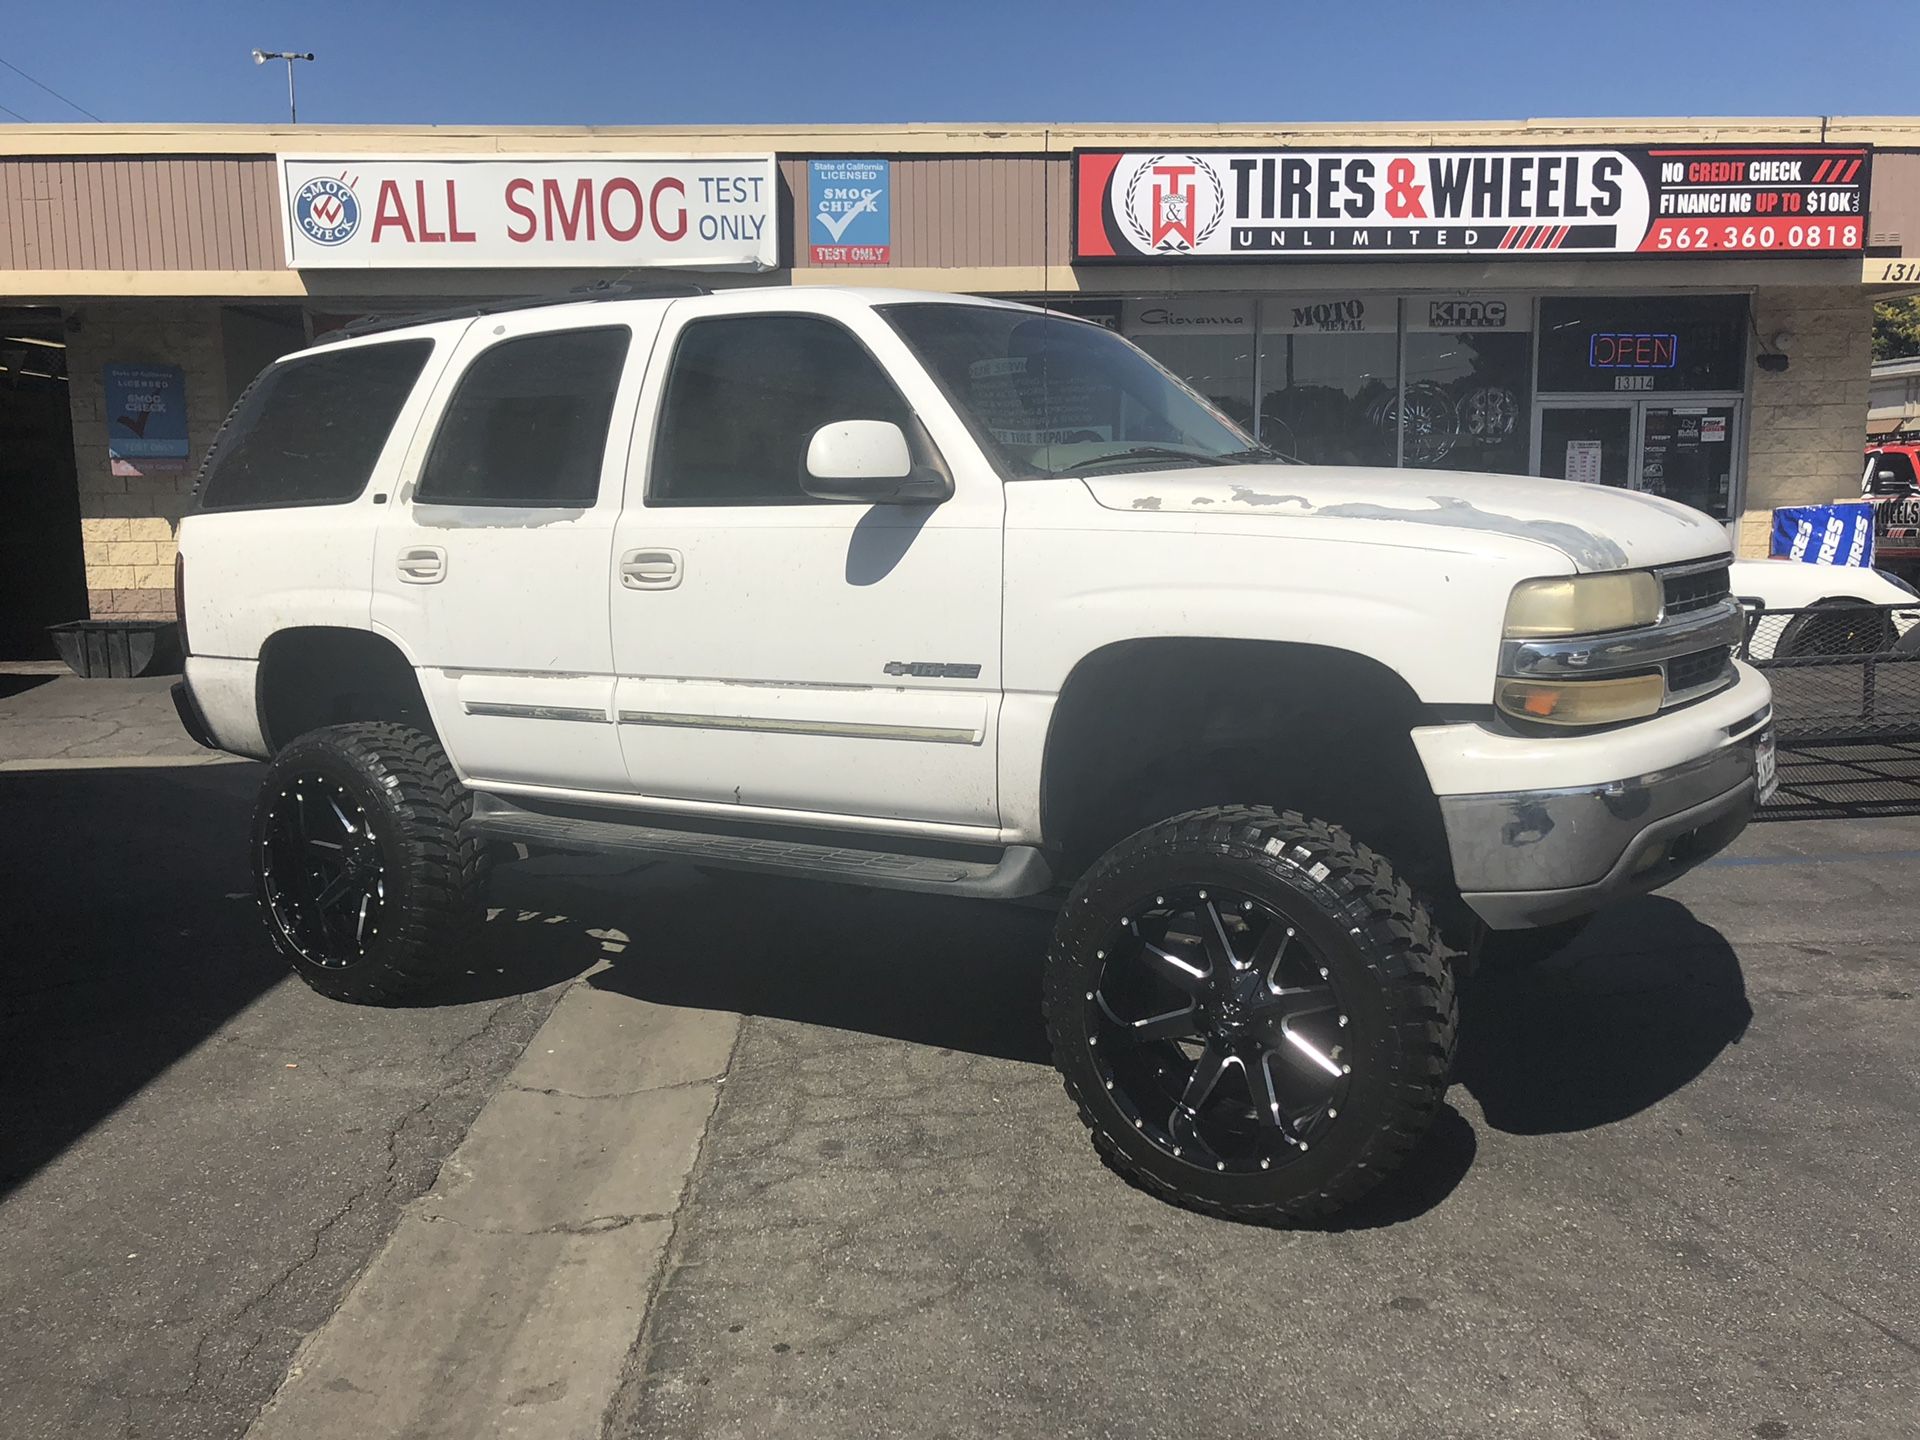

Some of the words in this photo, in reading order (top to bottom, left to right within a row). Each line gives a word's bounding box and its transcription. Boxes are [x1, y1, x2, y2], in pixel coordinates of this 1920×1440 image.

[814, 163, 835, 171] State
[836, 163, 845, 171] of
[846, 162, 884, 171] California
[821, 171, 877, 180] LICENSED
[1661, 162, 1685, 183] NO
[1688, 162, 1745, 182] CREDIT
[1749, 161, 1802, 182] CHECK
[301, 181, 350, 202] SMOG
[698, 177, 764, 204] TEST
[823, 188, 872, 200] SMOG
[1230, 158, 1375, 219] TIRES
[1429, 157, 1622, 218] WHEELS
[371, 179, 476, 242] ALL
[506, 178, 687, 242] SMOG
[818, 201, 879, 213] CHEK
[1659, 193, 1751, 214] FINANCING
[1755, 192, 1778, 213] UP
[1781, 192, 1800, 212] TO
[1806, 190, 1852, 214] $10K
[303, 217, 354, 240] CHECK
[698, 214, 766, 241] ONLY
[1657, 225, 1858, 249] 562.360.0818
[1239, 230, 1480, 247] UNLIMITED
[816, 247, 847, 261] TEST
[851, 247, 884, 261] ONLY
[1138, 308, 1244, 326] Giovanna
[1291, 299, 1365, 328] MOTO
[1318, 319, 1366, 332] METAL
[1617, 376, 1653, 390] 13114
